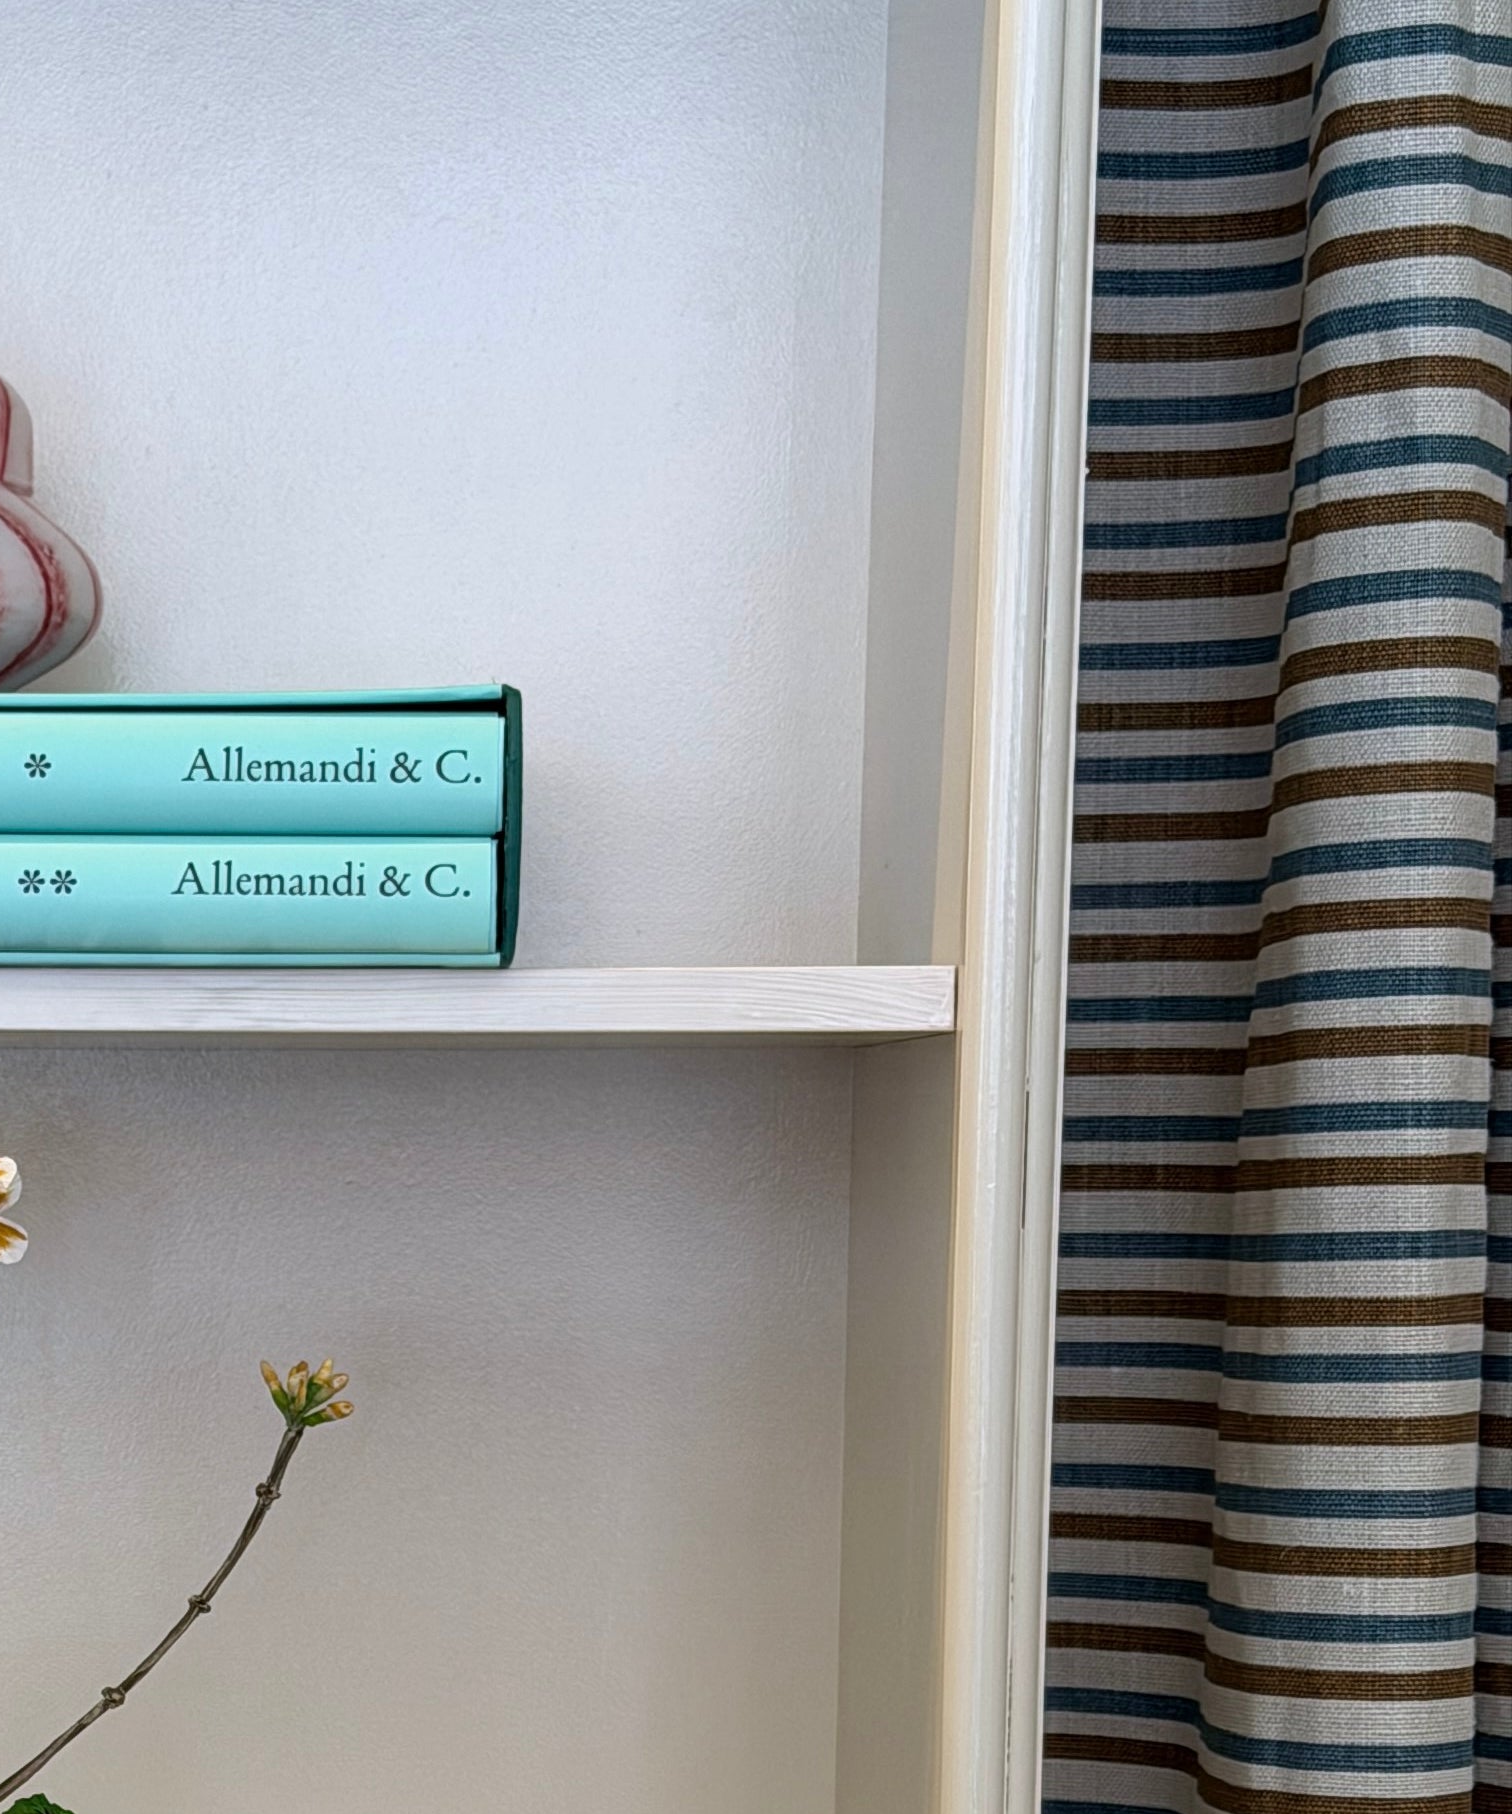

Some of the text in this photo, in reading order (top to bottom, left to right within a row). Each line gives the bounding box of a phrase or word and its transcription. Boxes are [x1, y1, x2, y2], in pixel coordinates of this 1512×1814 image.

[180, 745, 483, 785] Allemandi & C.
[170, 859, 472, 899] Allemandi & C.
